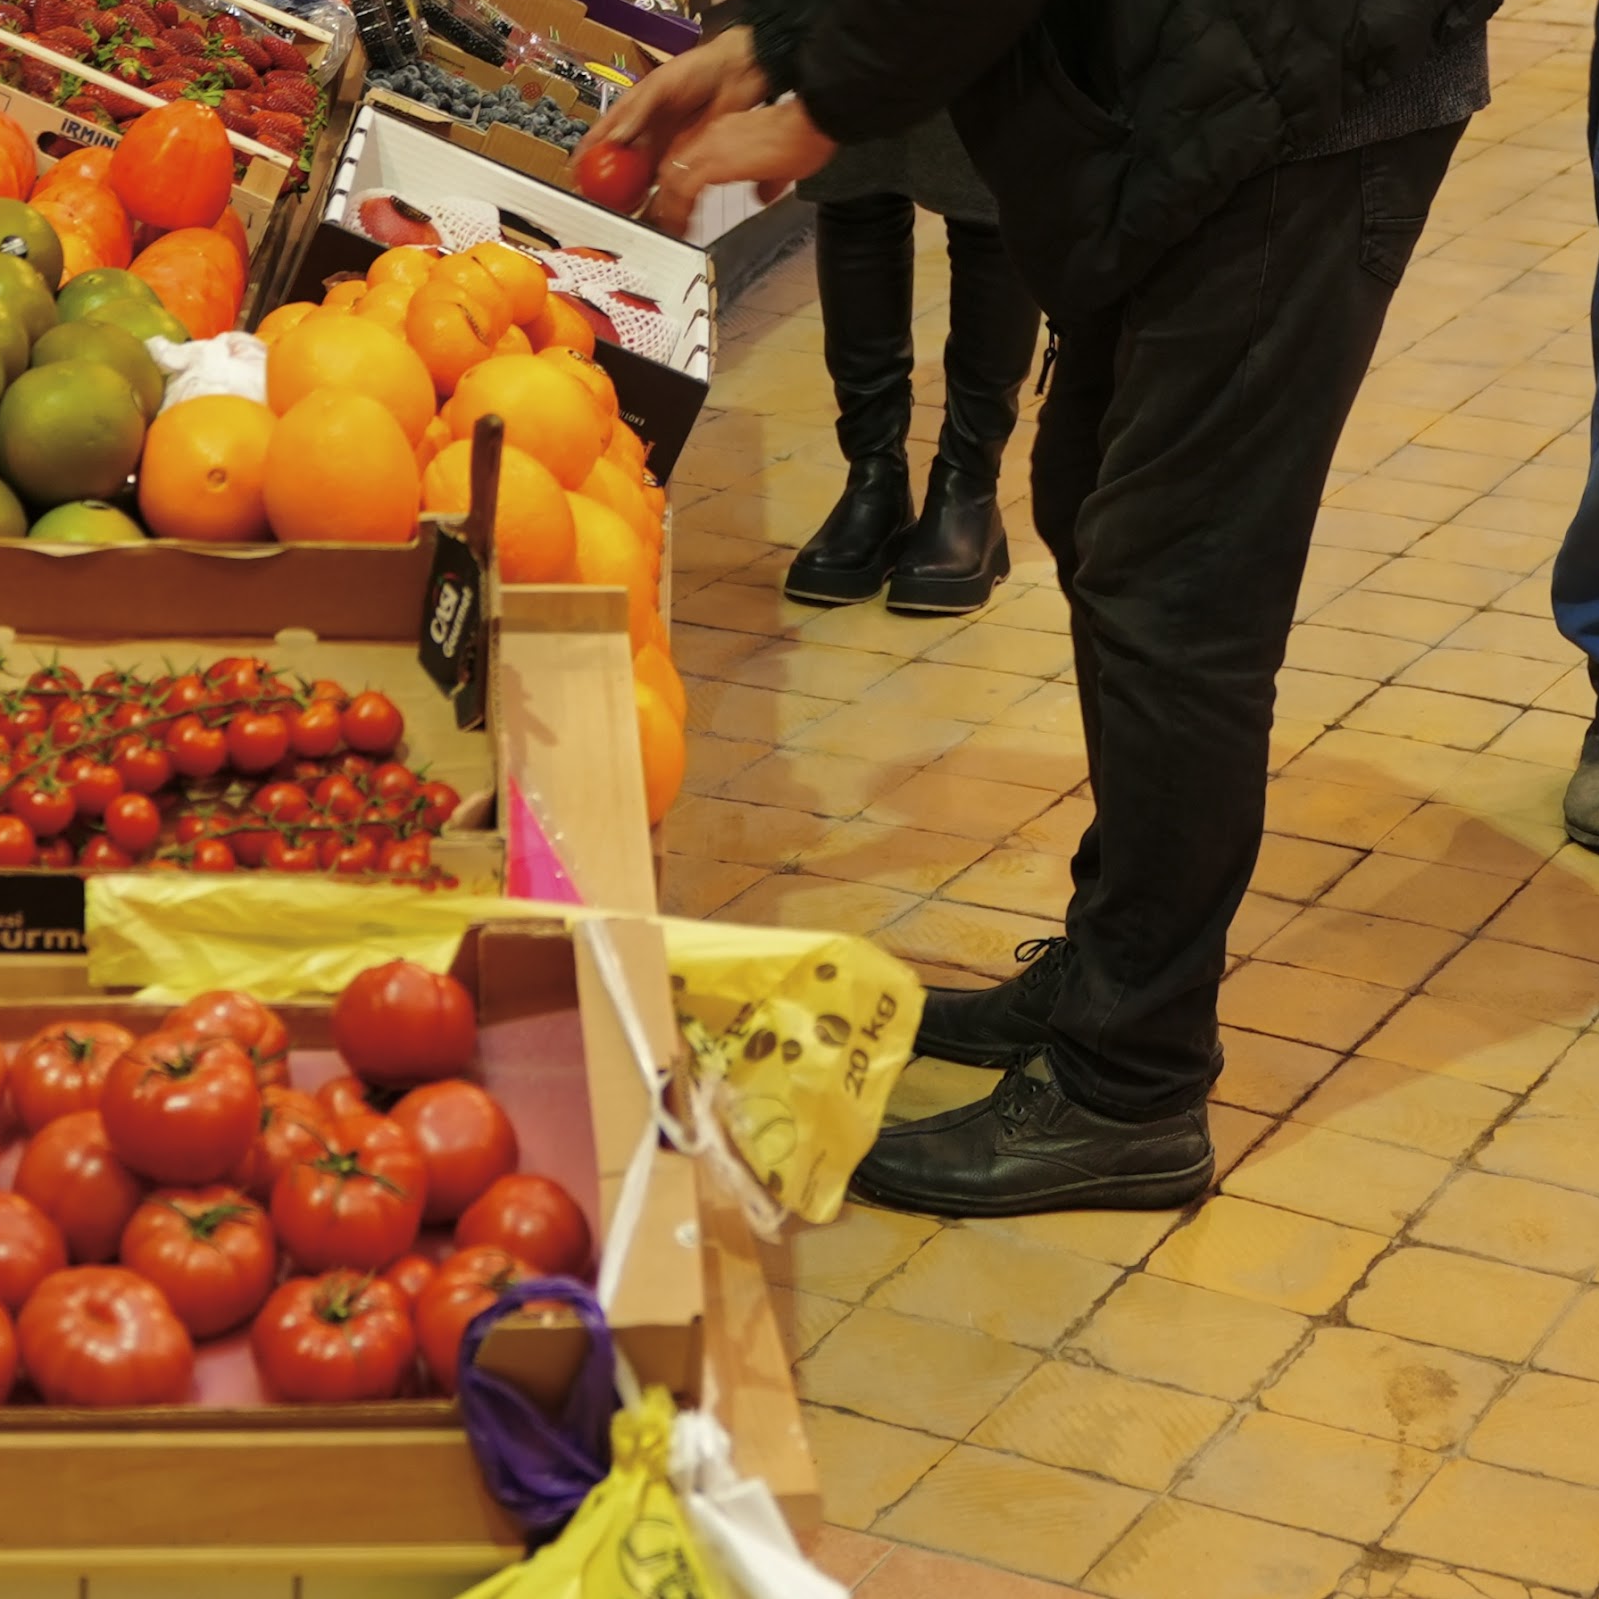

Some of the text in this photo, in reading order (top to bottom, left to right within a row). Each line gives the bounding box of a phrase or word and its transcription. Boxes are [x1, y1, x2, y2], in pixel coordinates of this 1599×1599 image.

[430, 582, 459, 644] CASI
[844, 991, 898, 1099] 20 kg
